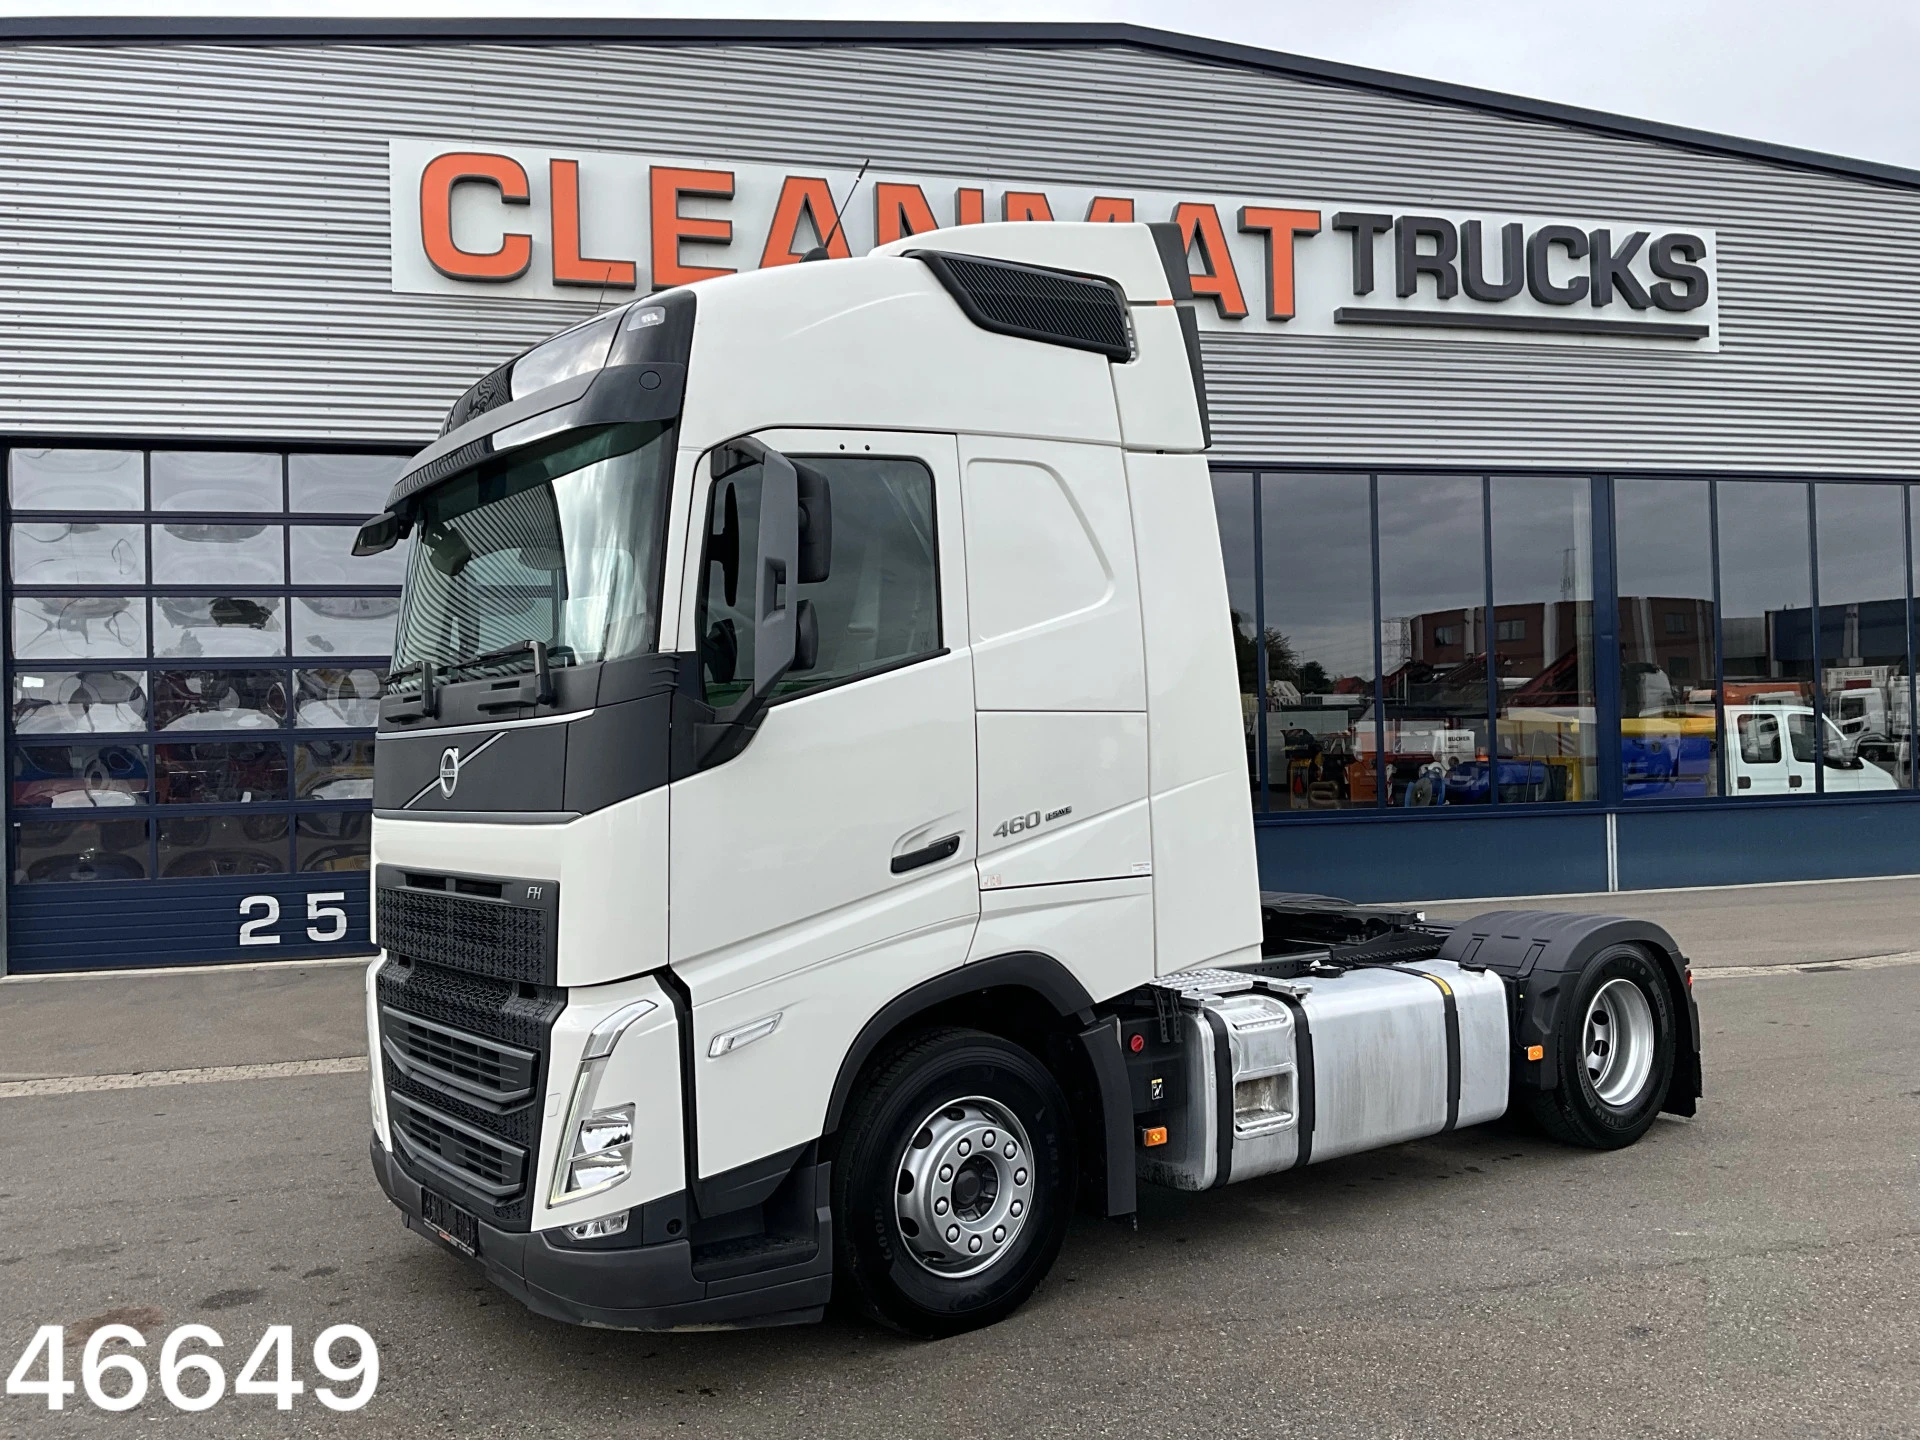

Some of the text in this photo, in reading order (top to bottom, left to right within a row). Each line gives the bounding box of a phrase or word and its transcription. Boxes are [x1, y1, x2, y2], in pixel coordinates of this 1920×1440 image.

[1331, 211, 1709, 312] TRUCKS
[993, 810, 1041, 838] 460
[527, 886, 543, 900] FH
